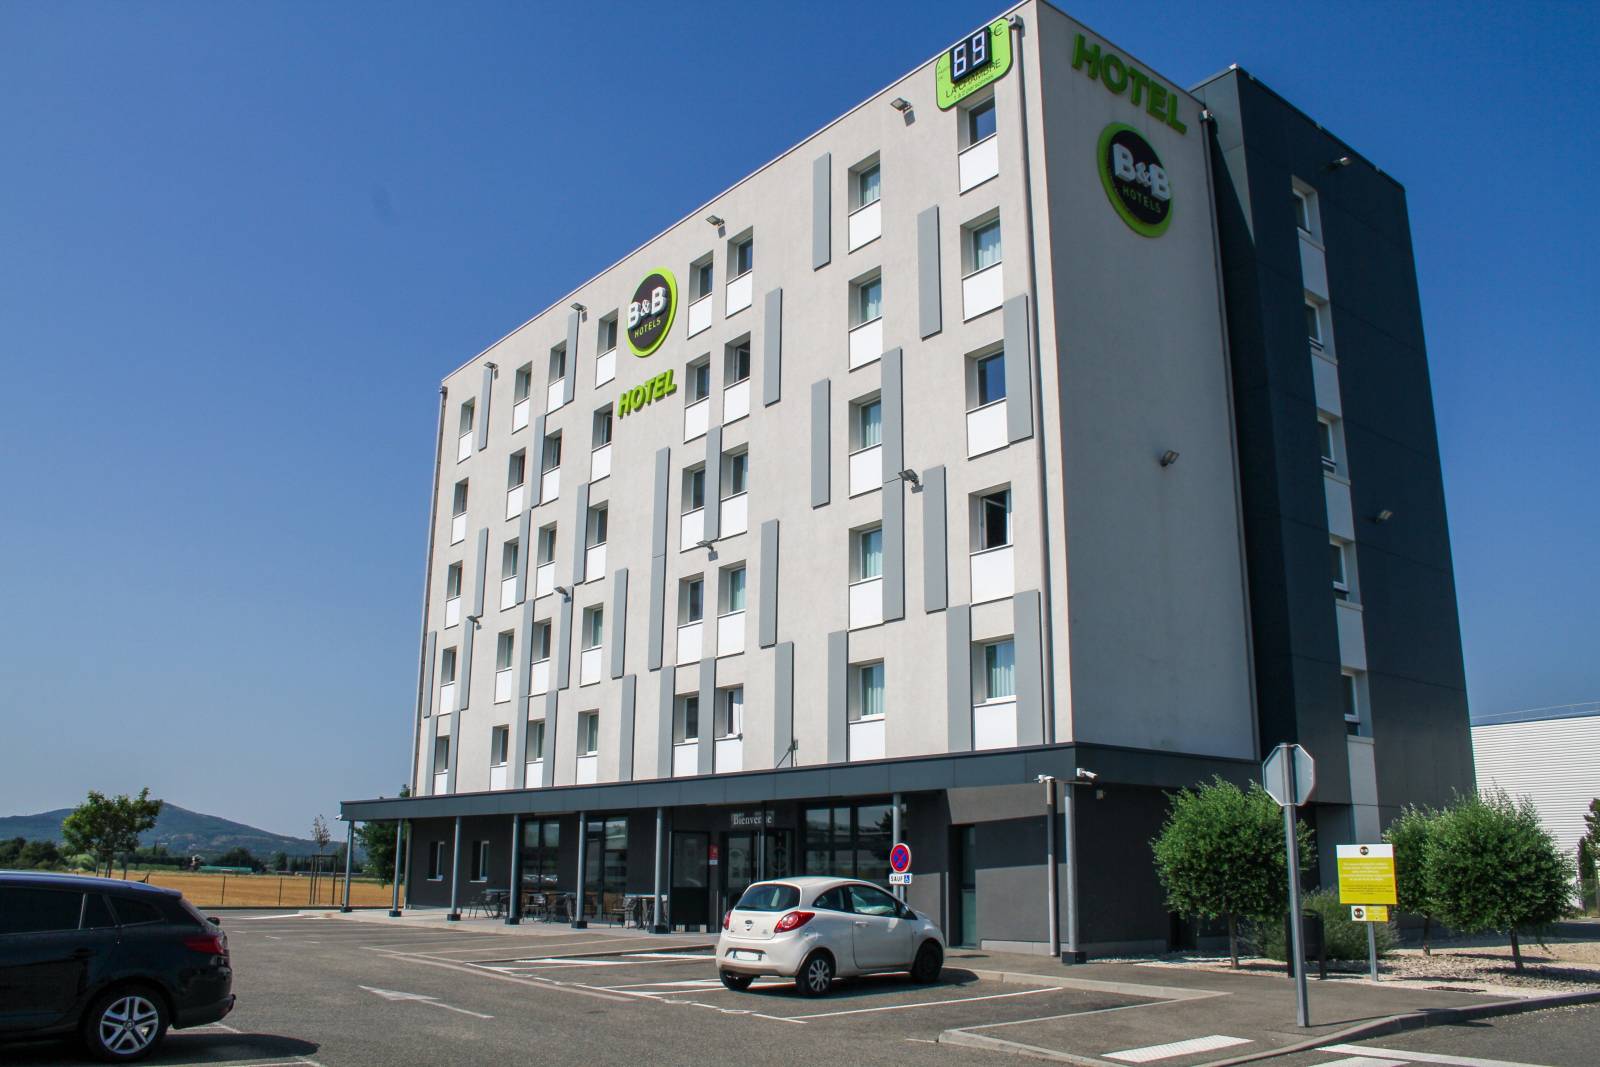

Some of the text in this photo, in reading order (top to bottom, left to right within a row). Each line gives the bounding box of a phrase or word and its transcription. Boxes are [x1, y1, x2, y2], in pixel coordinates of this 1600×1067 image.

[1072, 32, 1187, 135] HOTEL
[1113, 143, 1170, 201] B&B
[1121, 185, 1162, 214] HOTELS
[627, 286, 668, 330] B&B
[634, 318, 662, 338] HOTELS
[617, 368, 678, 420] HOTEL
[890, 874, 903, 882] SAUF
